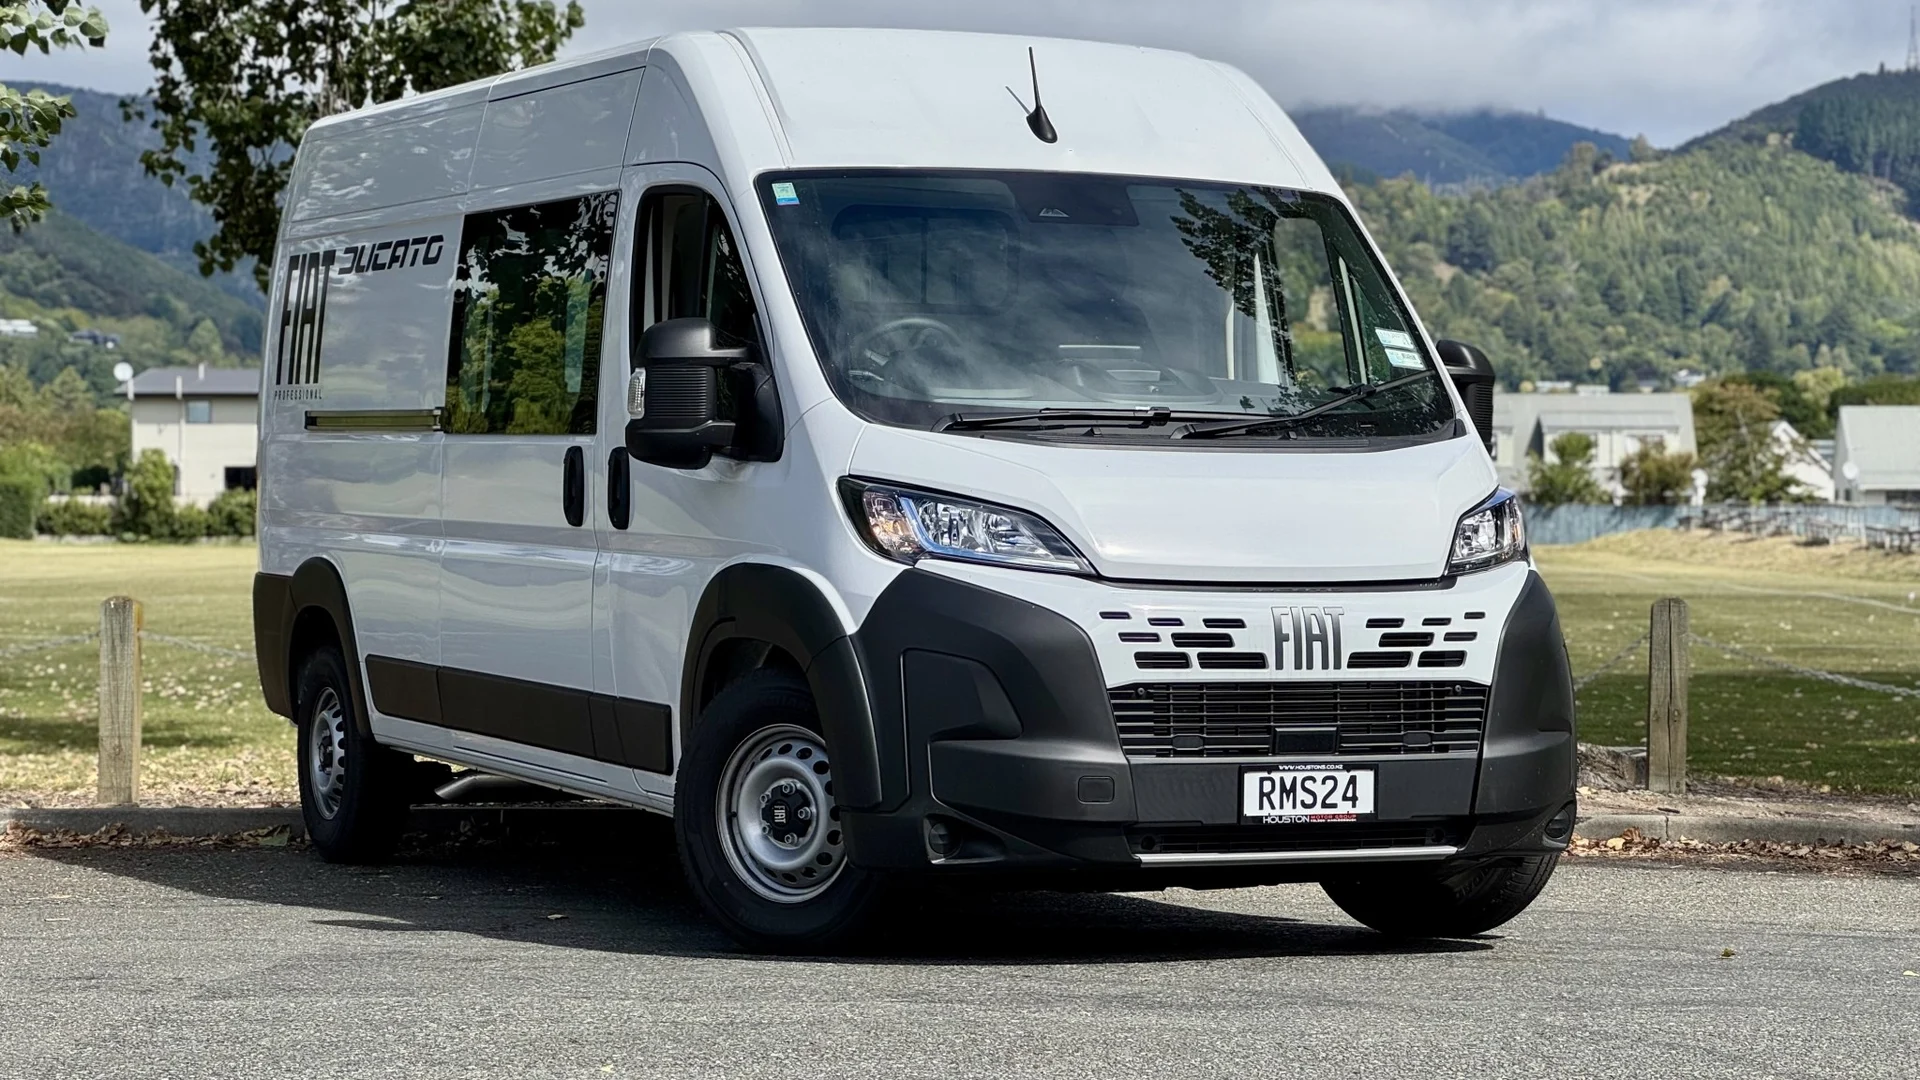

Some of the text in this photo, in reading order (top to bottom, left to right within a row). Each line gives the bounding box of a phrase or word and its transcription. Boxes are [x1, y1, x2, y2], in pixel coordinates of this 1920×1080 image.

[338, 235, 444, 275] DUCATO
[276, 249, 335, 386] FIAT
[274, 389, 322, 401] PROFESSIONAL
[1270, 606, 1345, 671] FIAT
[1258, 775, 1359, 811] RMS24
[774, 805, 786, 824] FIAT
[1262, 815, 1310, 824] HOUSTON
